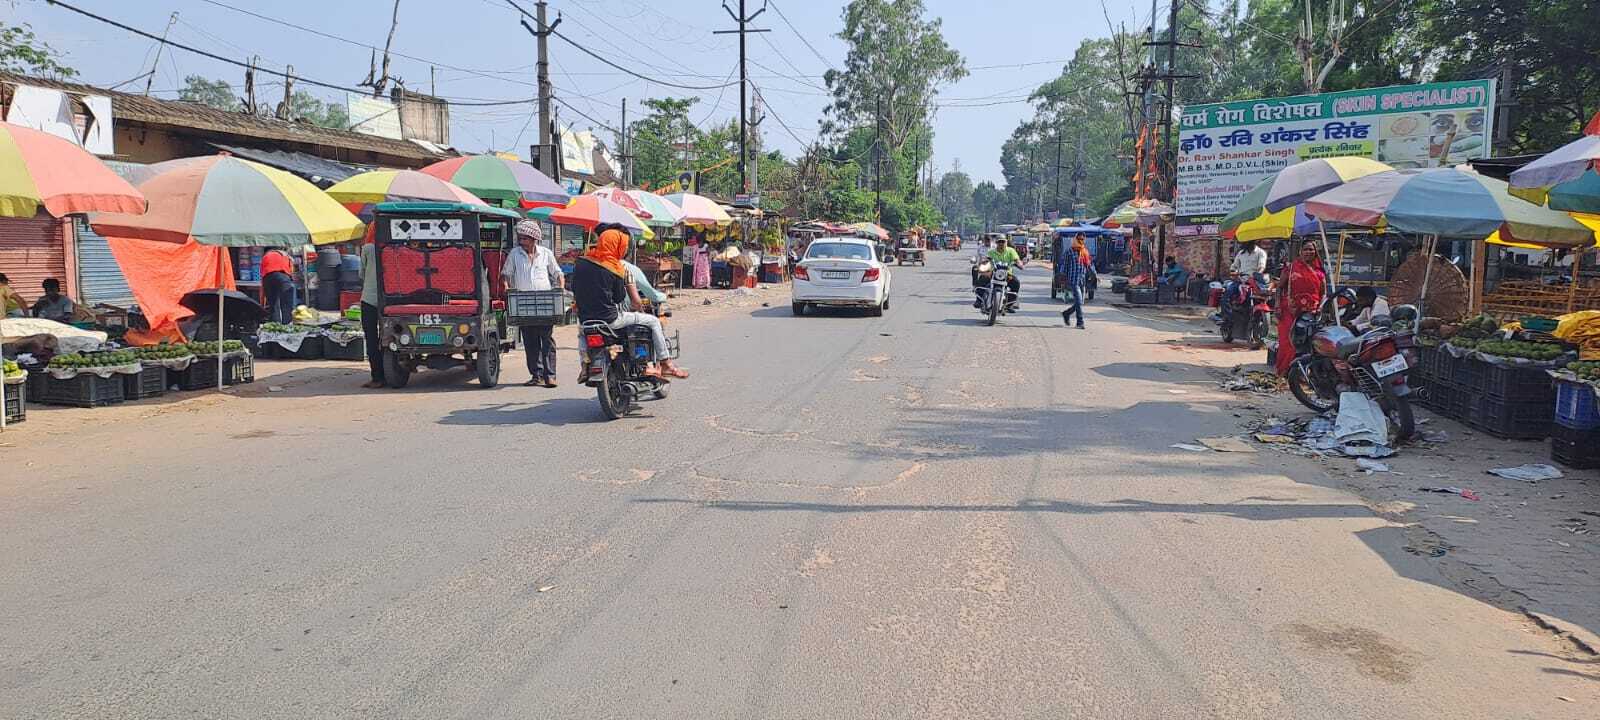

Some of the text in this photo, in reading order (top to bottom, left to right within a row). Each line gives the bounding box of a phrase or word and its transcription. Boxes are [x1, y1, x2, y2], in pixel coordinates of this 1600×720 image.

[1332, 86, 1485, 118] (SKIN SPECIALIST)
[1181, 108, 1209, 127] चर्म
[1215, 106, 1247, 125] रोग
[1218, 129, 1254, 148] रवि
[1259, 126, 1319, 144] शंकर
[1323, 121, 1371, 140] सिंह
[1194, 154, 1216, 162] Ravi
[1219, 151, 1261, 160] Shankar
[1264, 148, 1295, 158] Singh
